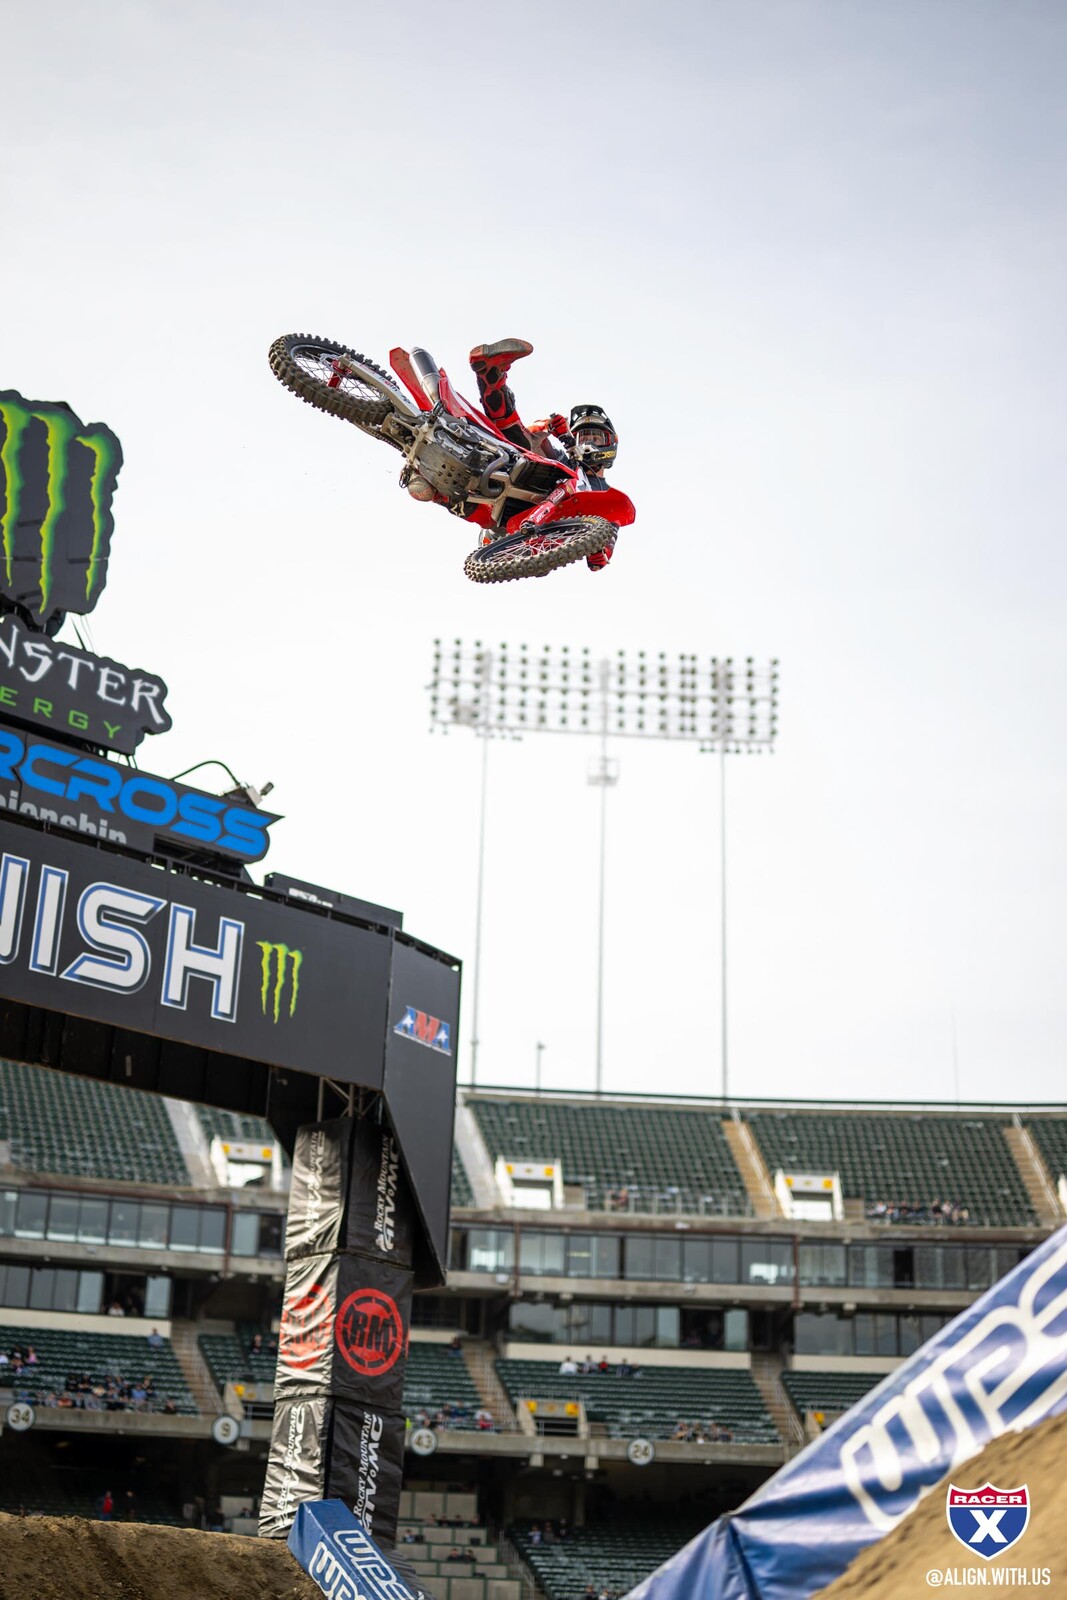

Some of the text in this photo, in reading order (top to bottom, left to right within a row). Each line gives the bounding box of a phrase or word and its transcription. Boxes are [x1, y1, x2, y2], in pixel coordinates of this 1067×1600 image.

[393, 1006, 452, 1052] AMA
[374, 1135, 390, 1232] ROCKY MOUNTAIN
[11, 1408, 30, 1424] 34
[221, 1421, 231, 1437] 9
[415, 1434, 433, 1448] 43
[632, 1443, 650, 1459] 24
[353, 1411, 373, 1516] ROCKY MOUNTAIN
